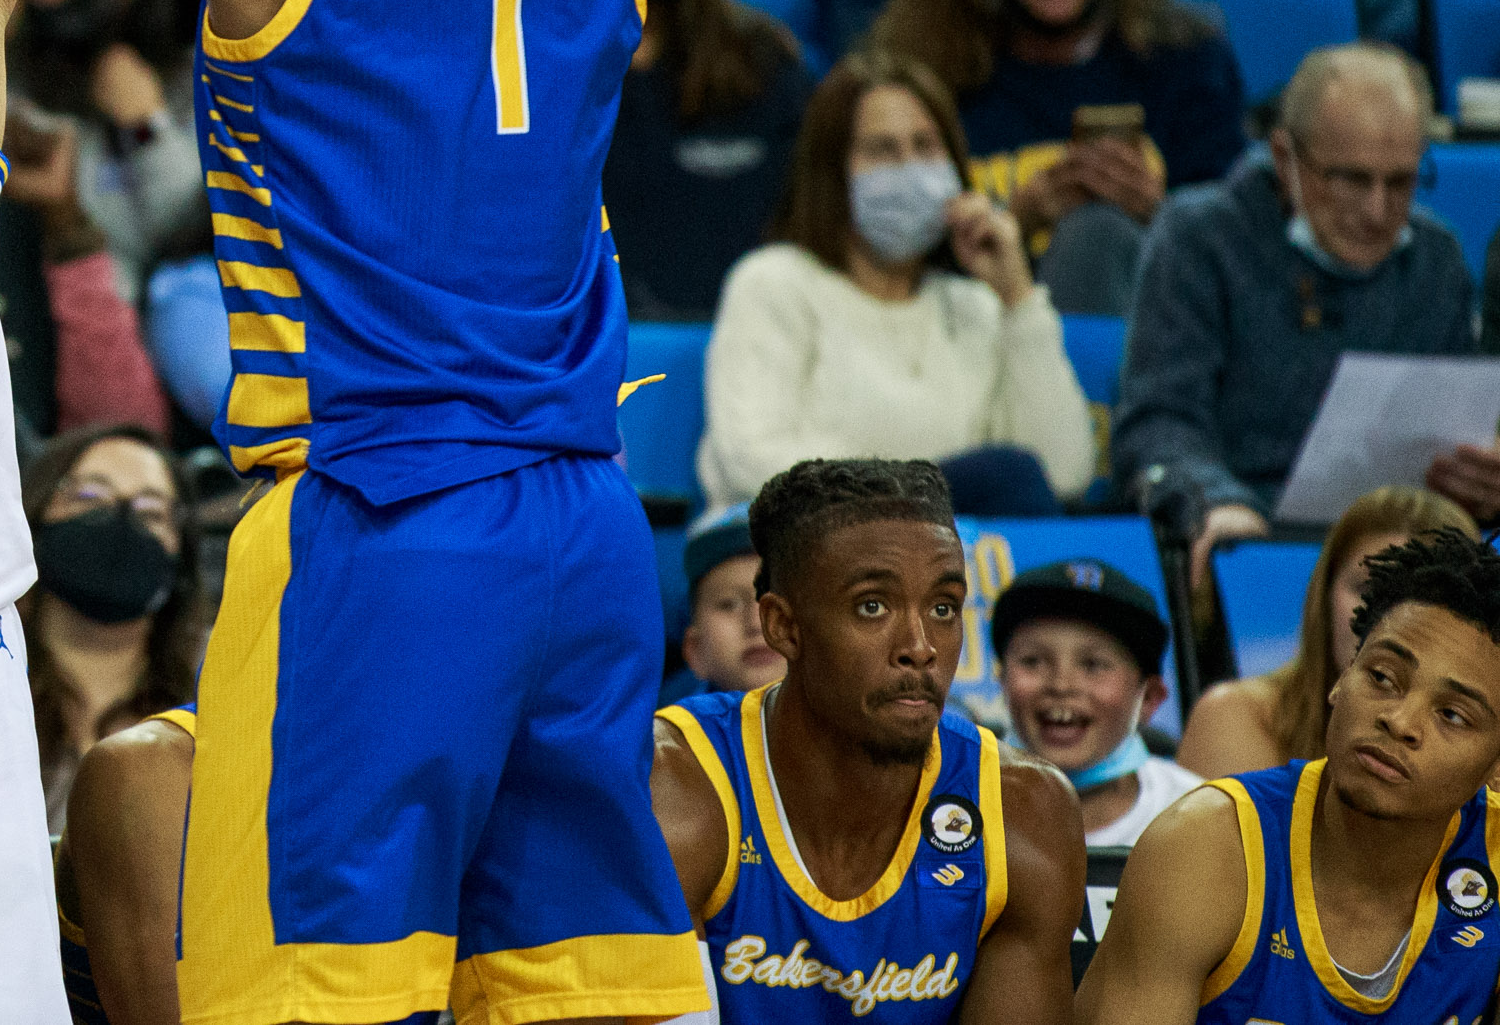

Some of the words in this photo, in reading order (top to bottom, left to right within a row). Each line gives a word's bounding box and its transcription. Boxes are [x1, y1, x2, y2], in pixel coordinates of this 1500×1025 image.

[930, 836, 953, 852] United
[1450, 904, 1473, 917] United
[1482, 897, 1495, 911] One
[721, 935, 959, 1016] Bakersfield
